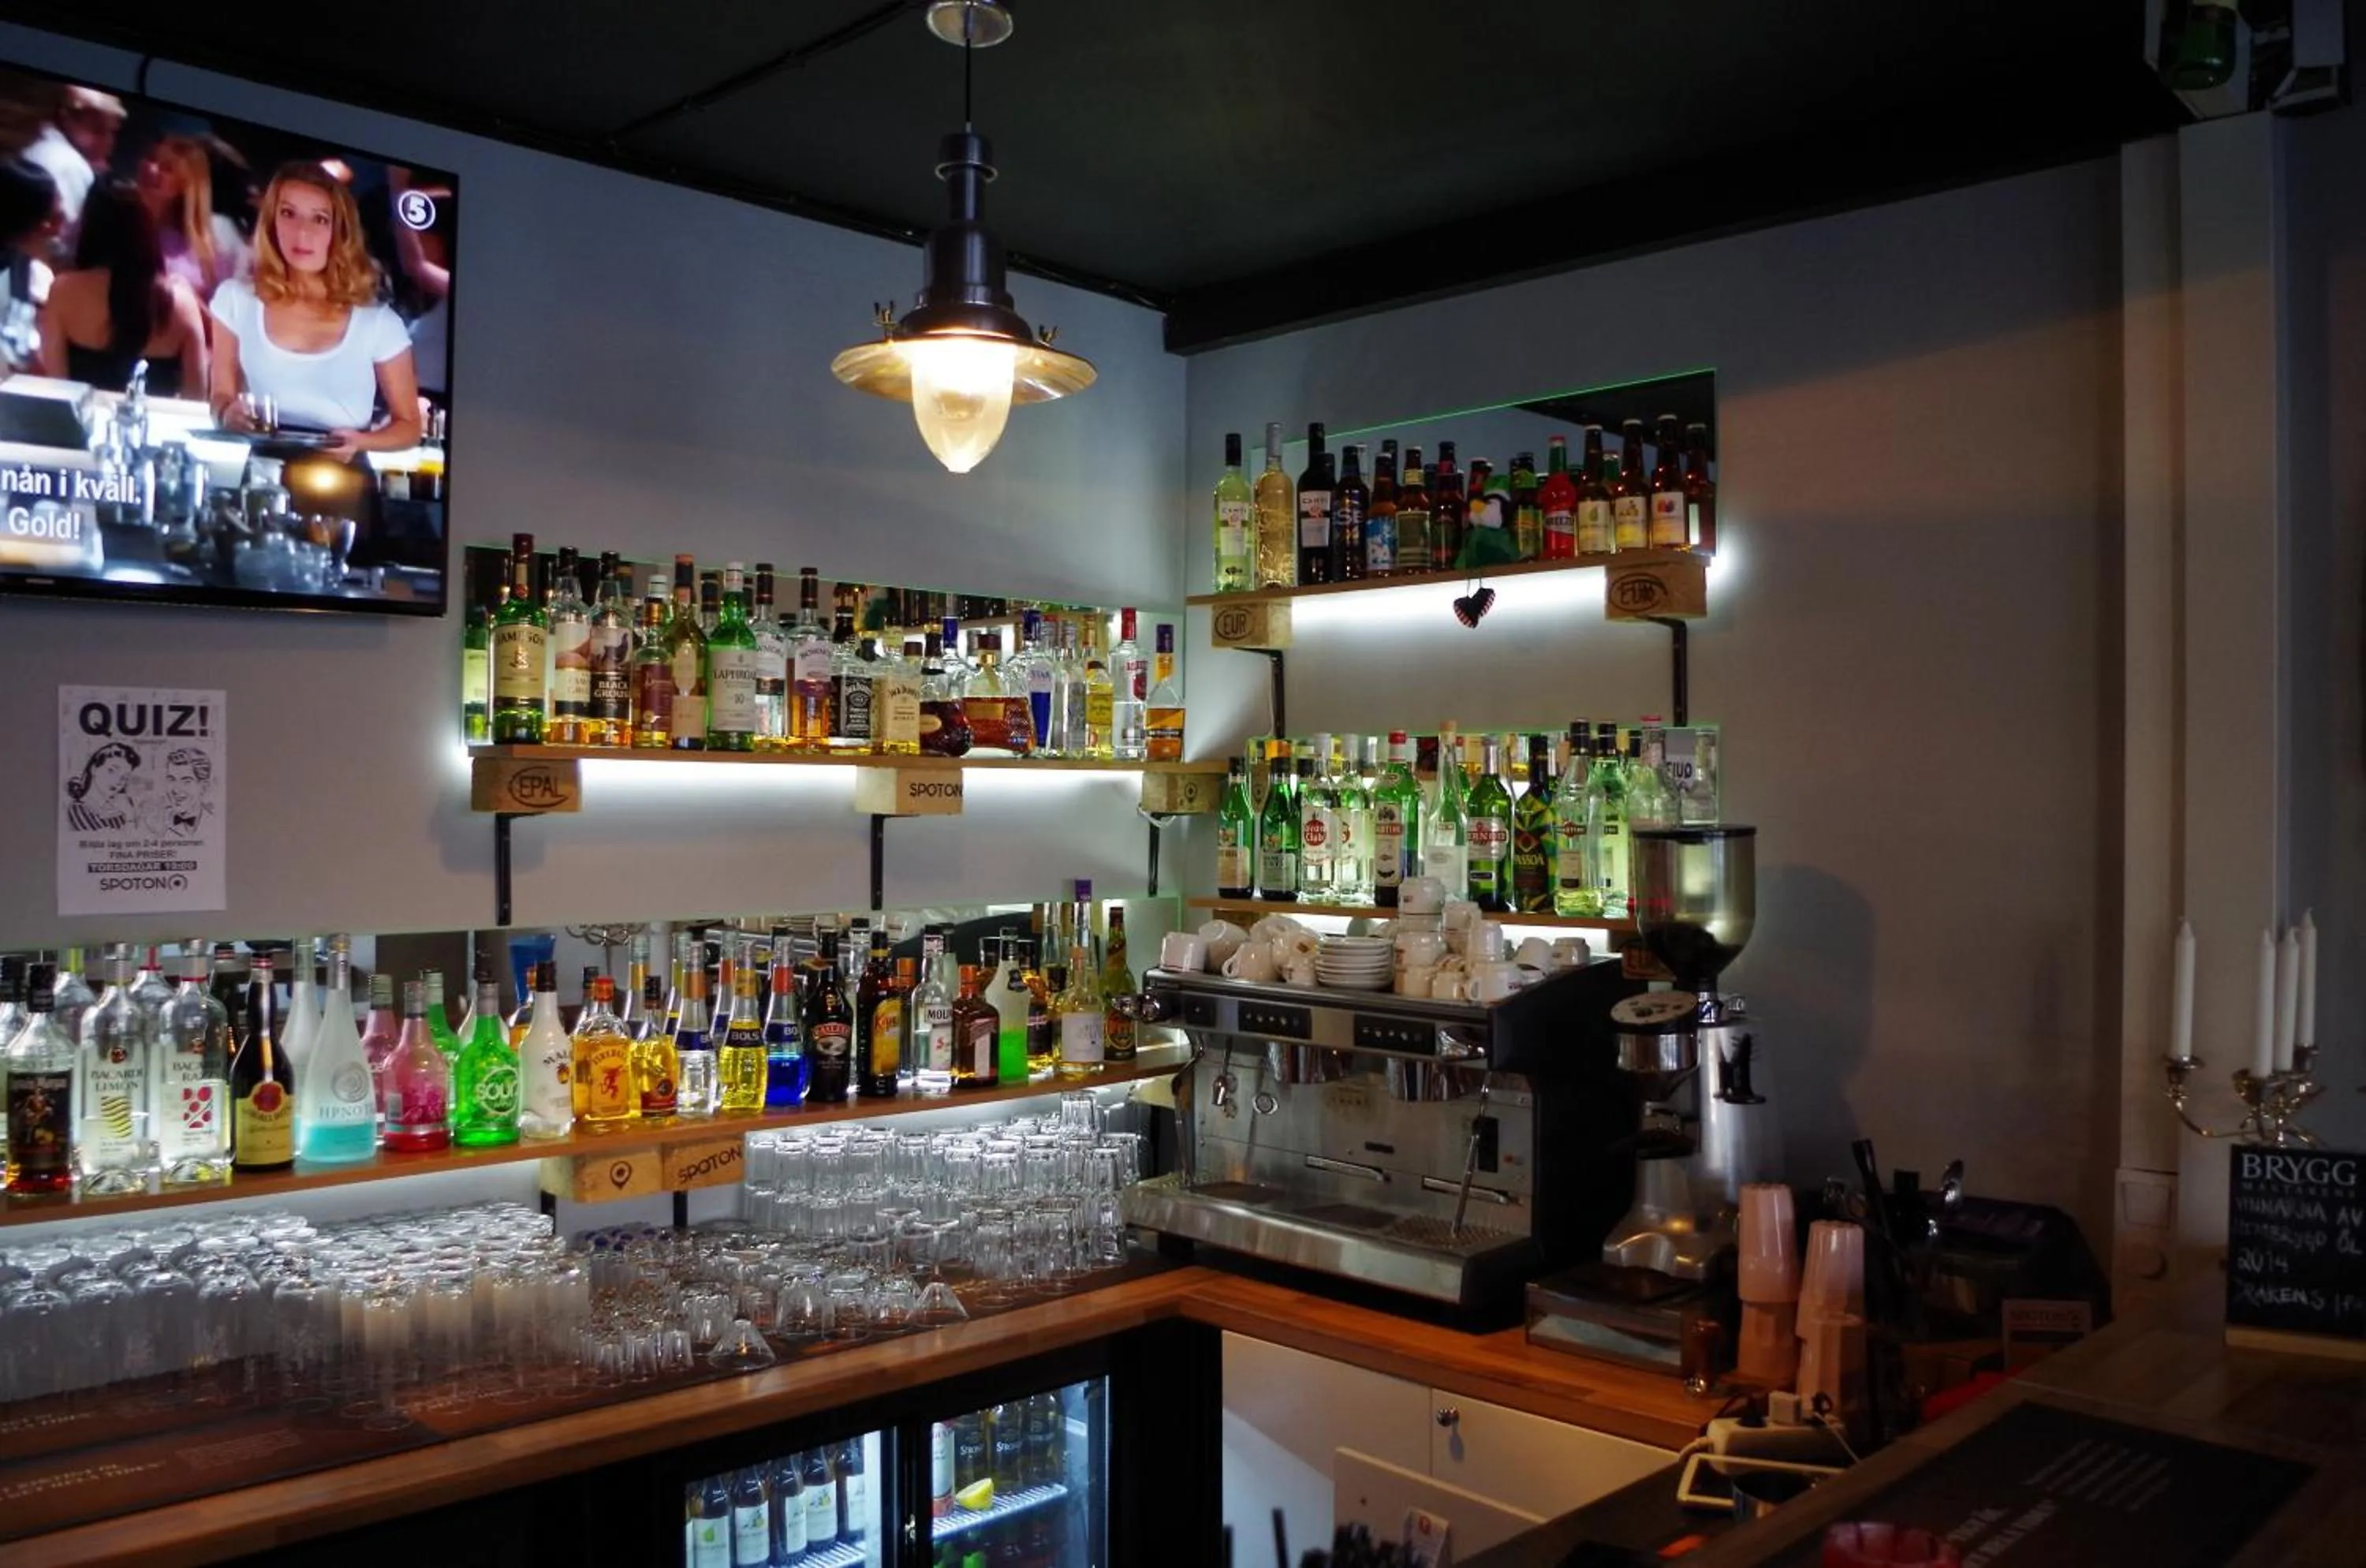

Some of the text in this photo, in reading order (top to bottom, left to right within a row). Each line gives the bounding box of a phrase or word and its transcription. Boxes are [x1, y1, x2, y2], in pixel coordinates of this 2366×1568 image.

[2, 464, 142, 505] nån i kväll.
[9, 507, 80, 539] Gold!
[1224, 613, 1246, 635] EUR
[79, 701, 208, 737] QUIZ!
[519, 775, 566, 798] EPAL
[909, 783, 962, 797] SPOTON
[100, 876, 166, 890] SPOTON
[730, 1027, 759, 1039] BOLS
[91, 1068, 144, 1080] BACARDI
[677, 1145, 742, 1185] SPOTON
[2241, 1153, 2357, 1186] BRYGG
[2336, 1207, 2364, 1227] AV
